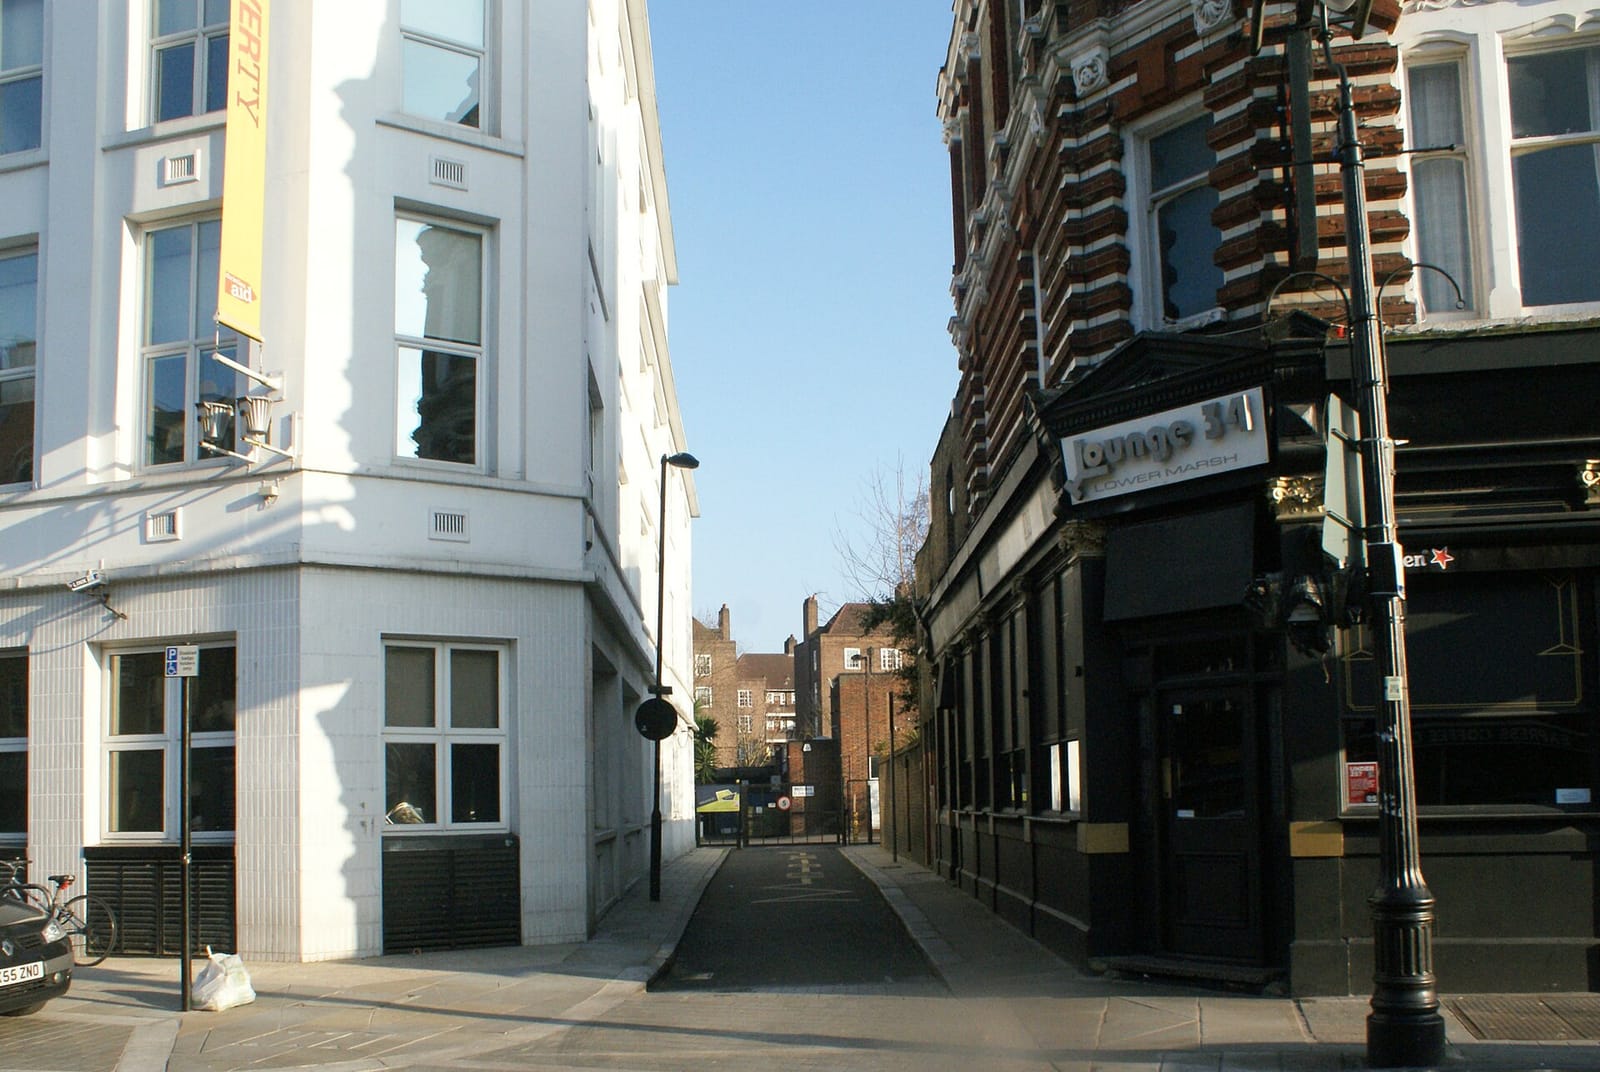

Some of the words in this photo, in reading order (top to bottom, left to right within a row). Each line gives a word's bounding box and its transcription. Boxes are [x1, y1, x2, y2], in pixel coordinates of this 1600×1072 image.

[231, 284, 252, 303] aid
[1201, 394, 1253, 440] 34
[1094, 471, 1161, 493] LOWER
[1165, 453, 1238, 477] MARSH
[169, 648, 177, 660] P
[0, 968, 17, 983] 55
